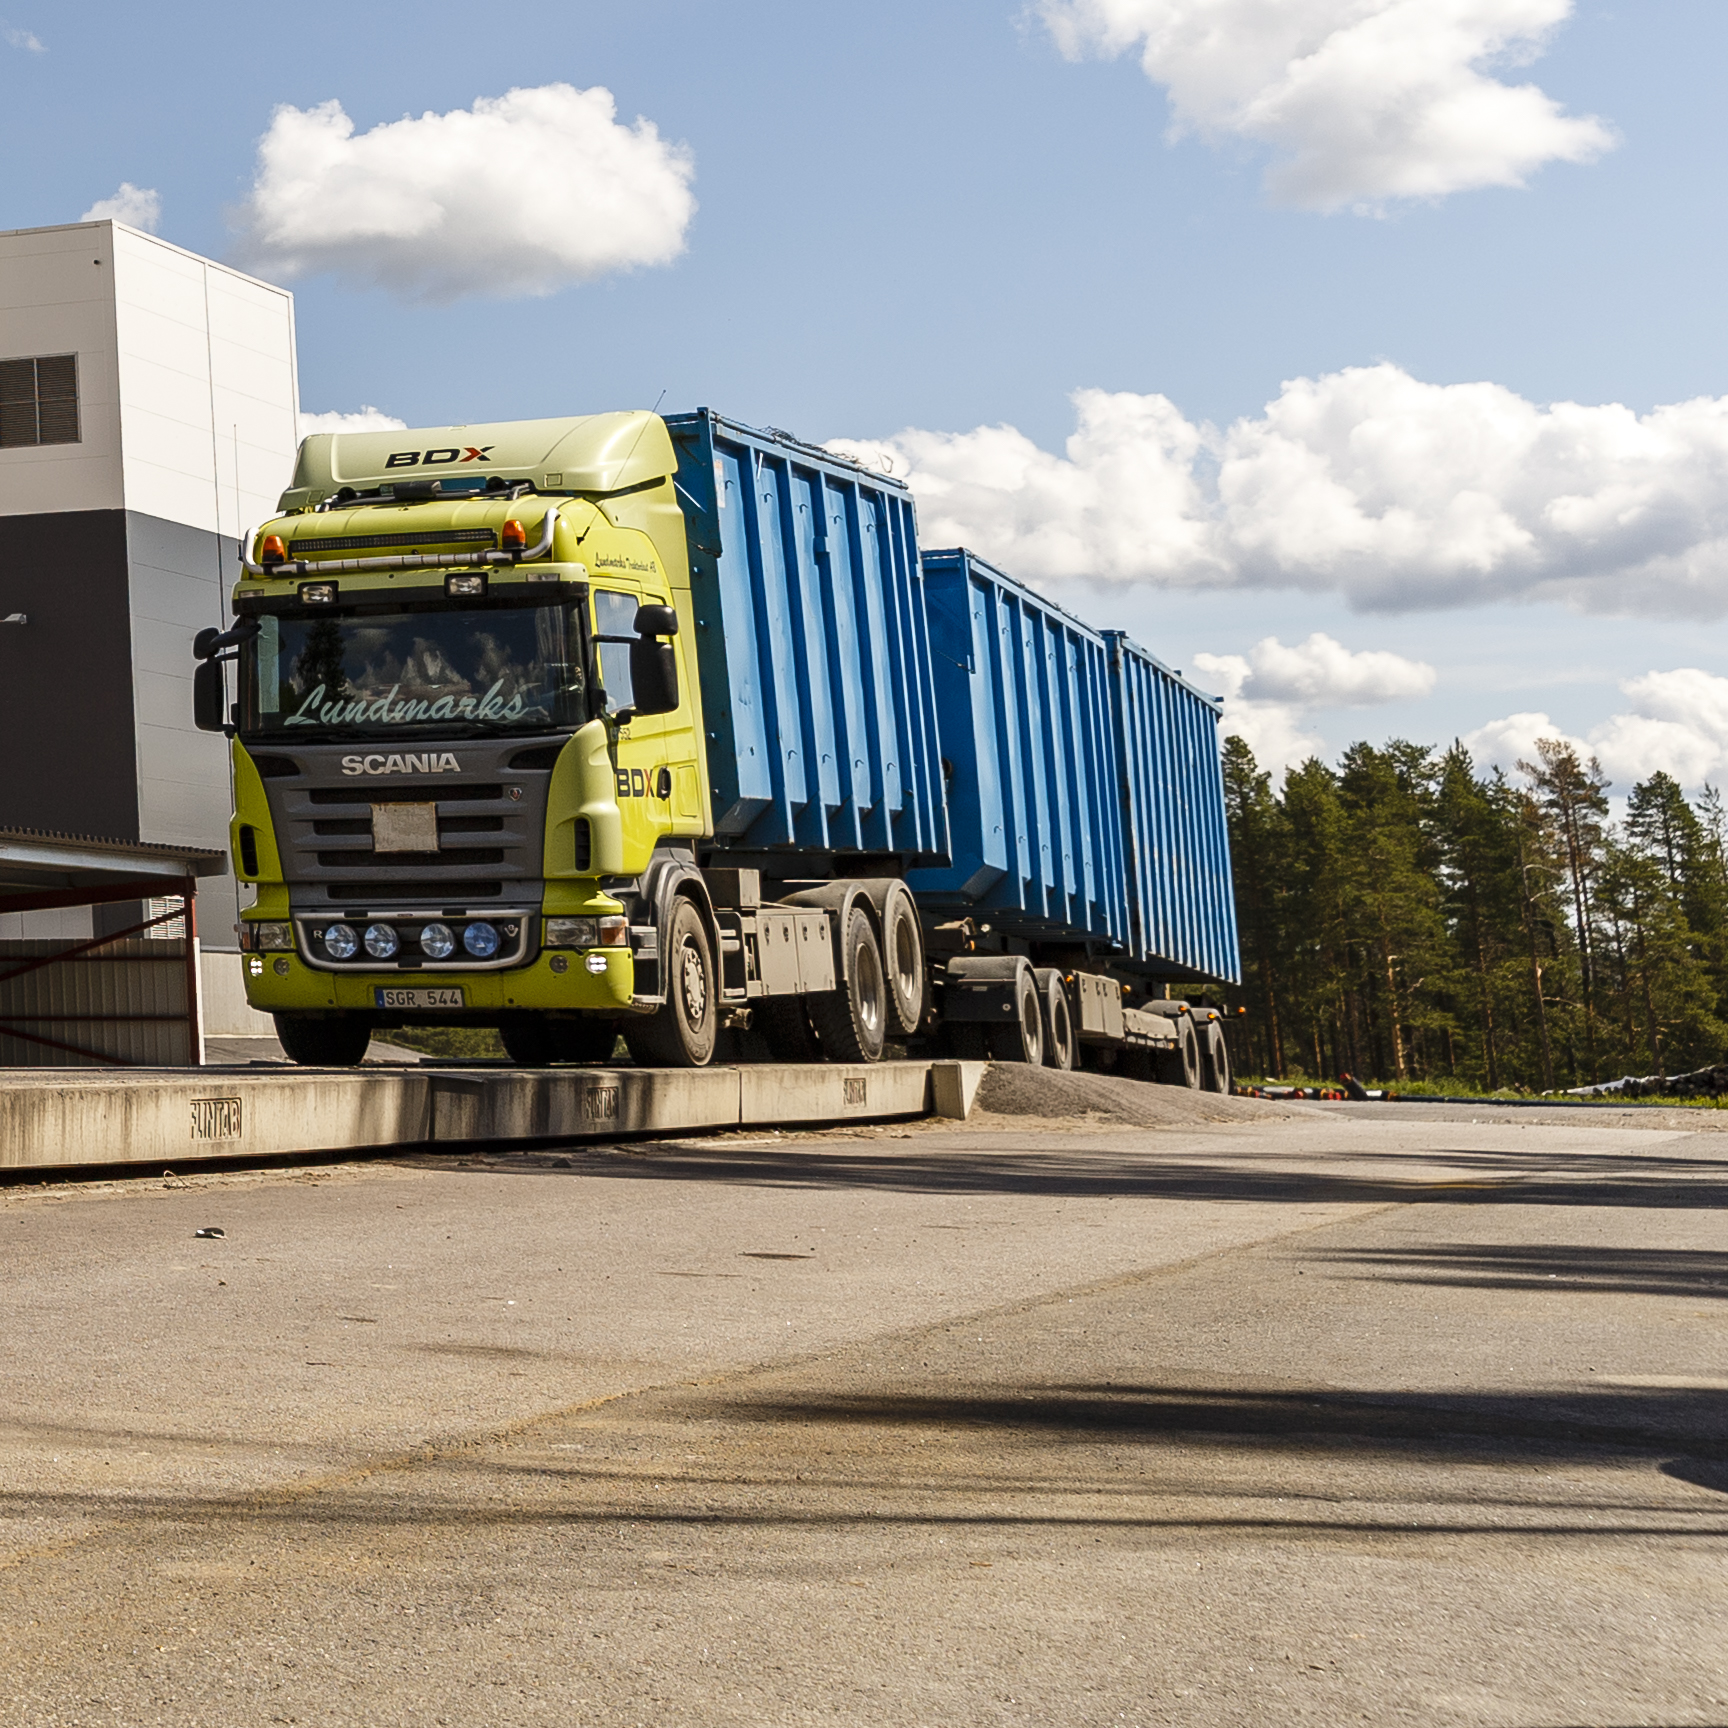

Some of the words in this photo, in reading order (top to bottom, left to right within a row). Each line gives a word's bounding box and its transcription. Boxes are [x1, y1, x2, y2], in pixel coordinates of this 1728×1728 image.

[385, 445, 496, 469] BDX
[283, 677, 529, 727] Lundmarks
[341, 752, 461, 776] SCANIA
[616, 768, 655, 799] BDX
[313, 929, 323, 939] R
[385, 990, 415, 1006] SGR
[426, 990, 460, 1006] 544
[190, 1100, 240, 1142] FLINTAB
